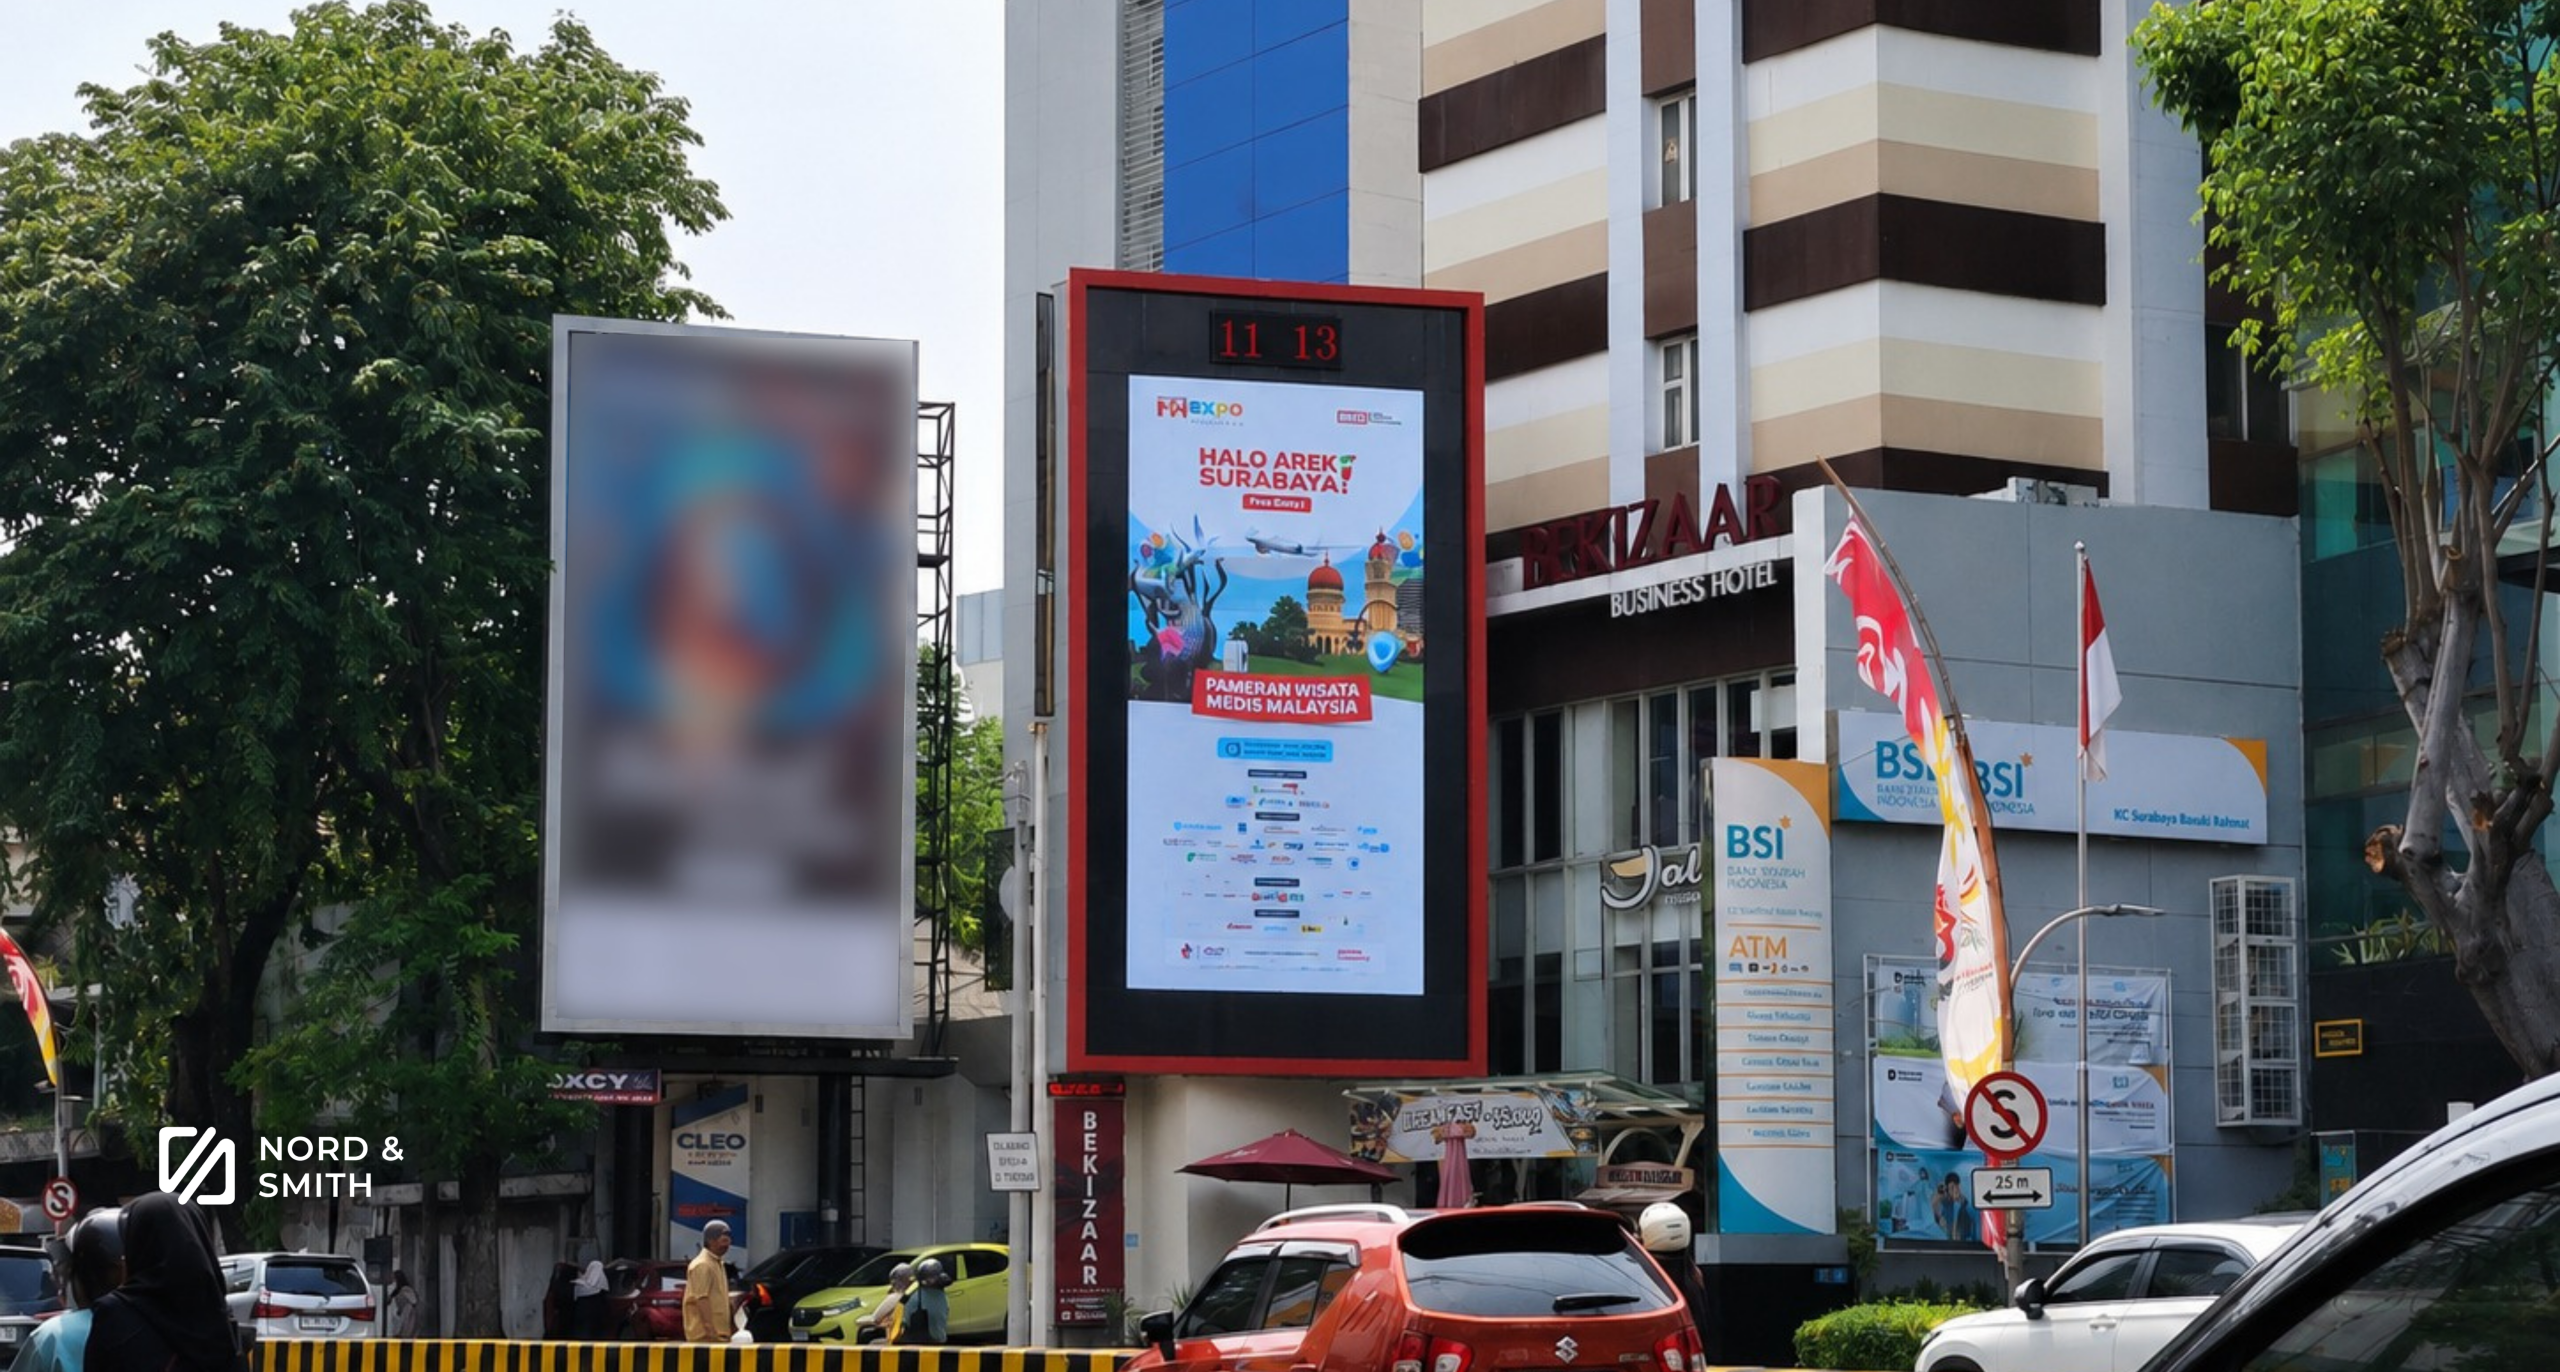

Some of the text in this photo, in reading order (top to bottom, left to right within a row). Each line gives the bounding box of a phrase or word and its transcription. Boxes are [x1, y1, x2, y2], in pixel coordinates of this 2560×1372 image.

[1219, 320, 1338, 361] 11 13
[1199, 447, 1338, 473] HALO AREK
[1520, 475, 1782, 591] BEKIZAAR
[1610, 560, 1778, 618] BUSINESS HOTEL
[1206, 677, 1361, 698] PAMERAN WISATA
[1206, 694, 1359, 715] MEDIS MALAYSIA
[1726, 824, 1784, 860] BSI
[1728, 935, 1787, 959] ATM
[676, 1132, 747, 1150] CLEO
[1995, 1175, 2029, 1190] 25 m
[1080, 1110, 1099, 1286] BEKIZAAR
